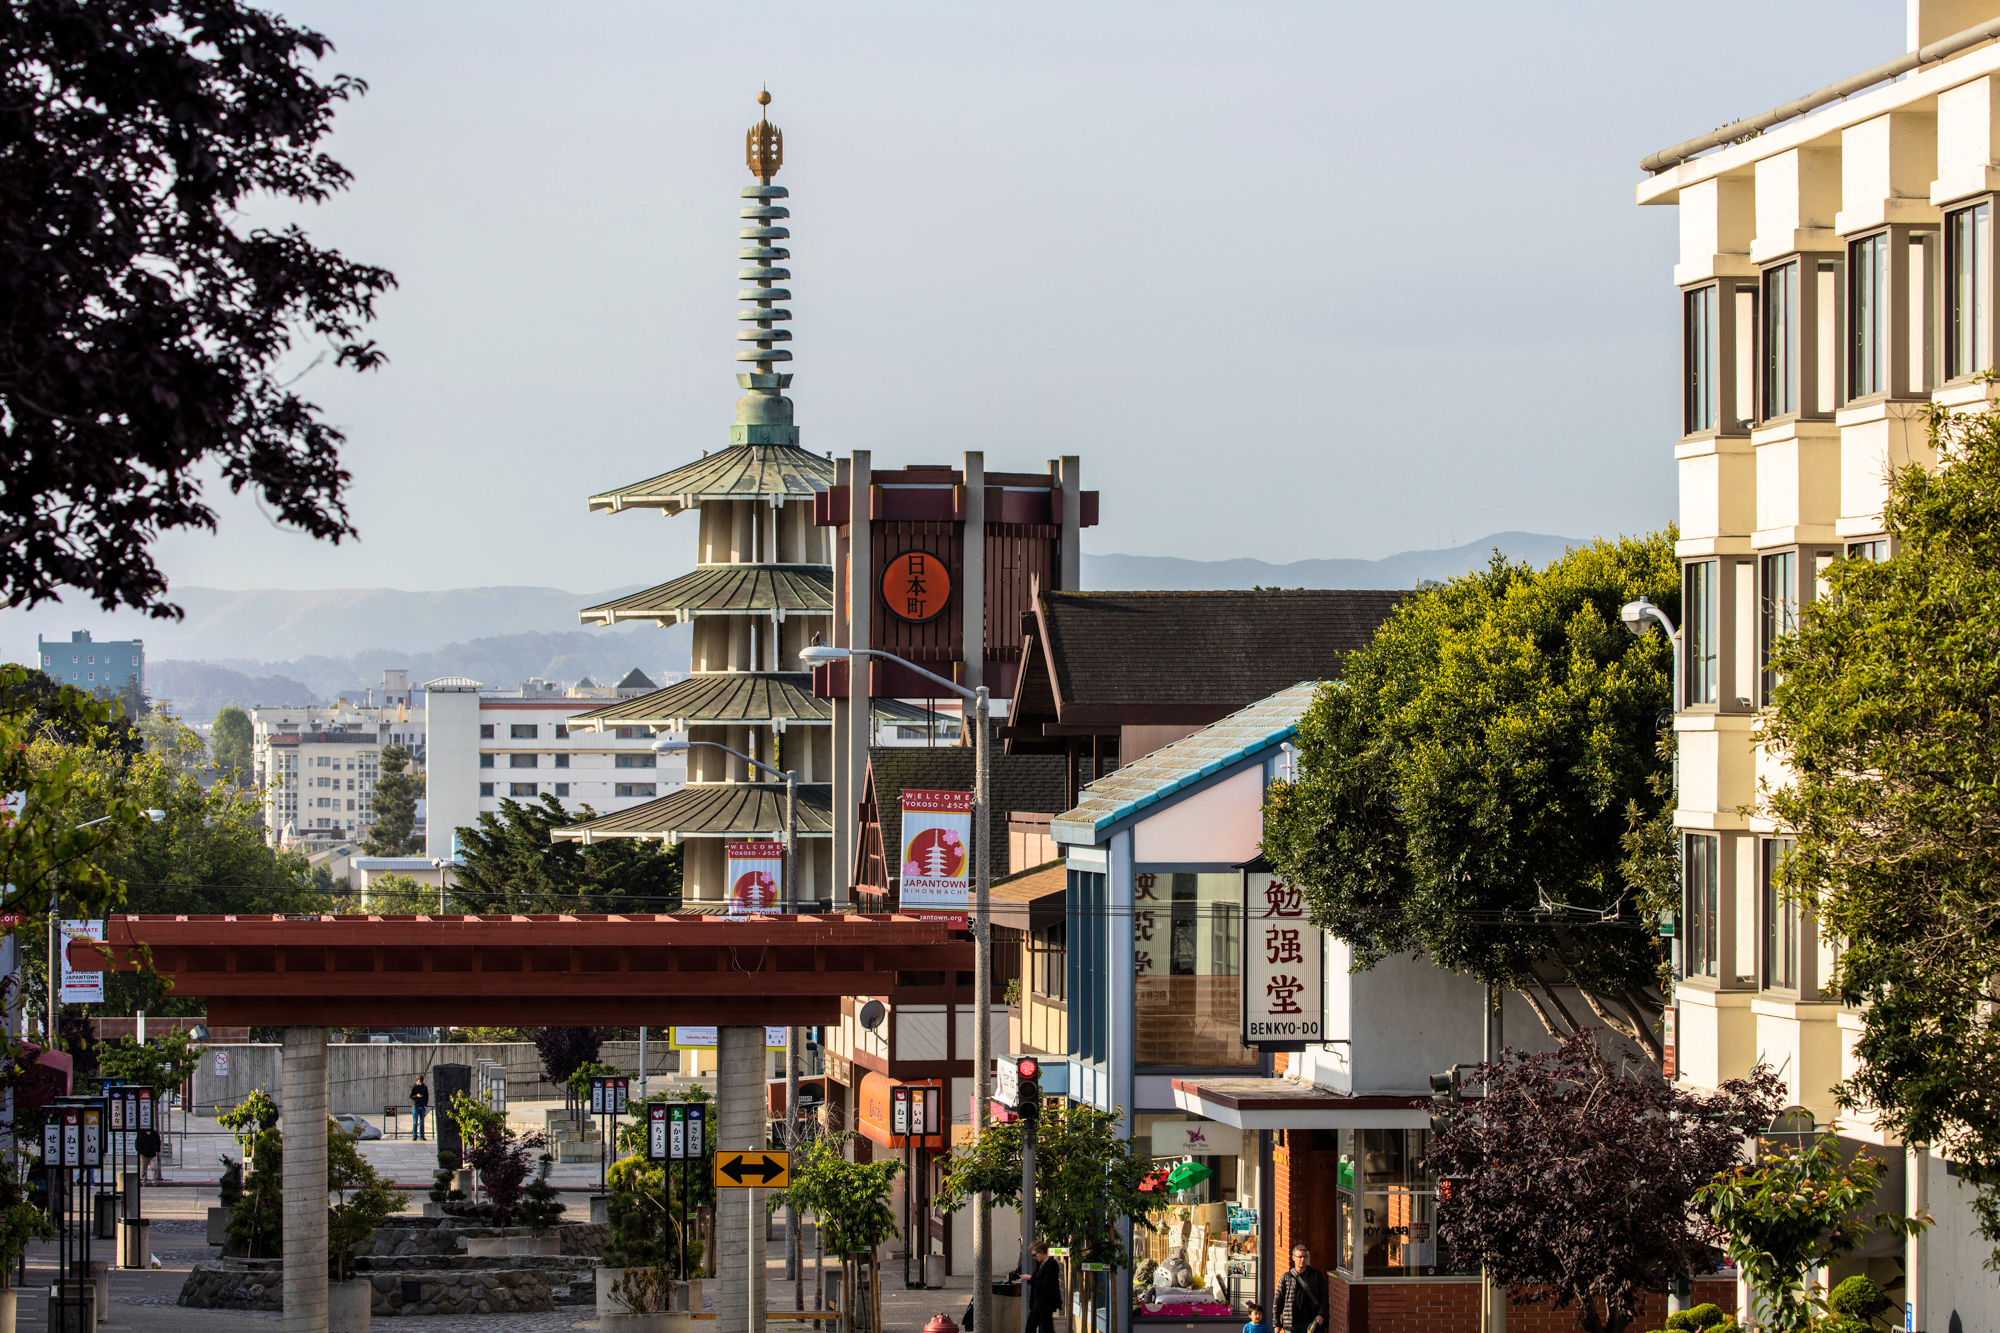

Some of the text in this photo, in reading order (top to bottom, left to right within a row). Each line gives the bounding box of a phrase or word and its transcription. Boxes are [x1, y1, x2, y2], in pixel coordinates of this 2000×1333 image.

[906, 555, 927, 618] 日本町
[903, 879, 967, 888] JAPANTOWN
[1250, 1022, 1318, 1035] BENKYO-DO
[897, 1108, 905, 1124] ねこ
[914, 1110, 922, 1125] いぬ
[47, 1134, 58, 1155] せみ
[66, 1135, 76, 1155] ねこ
[87, 1134, 96, 1154] いぬ
[673, 1128, 681, 1152] かえる
[691, 1126, 699, 1150] さかな
[1182, 1142, 1198, 1150] Paper
[1410, 1229, 1429, 1238] OPEN
